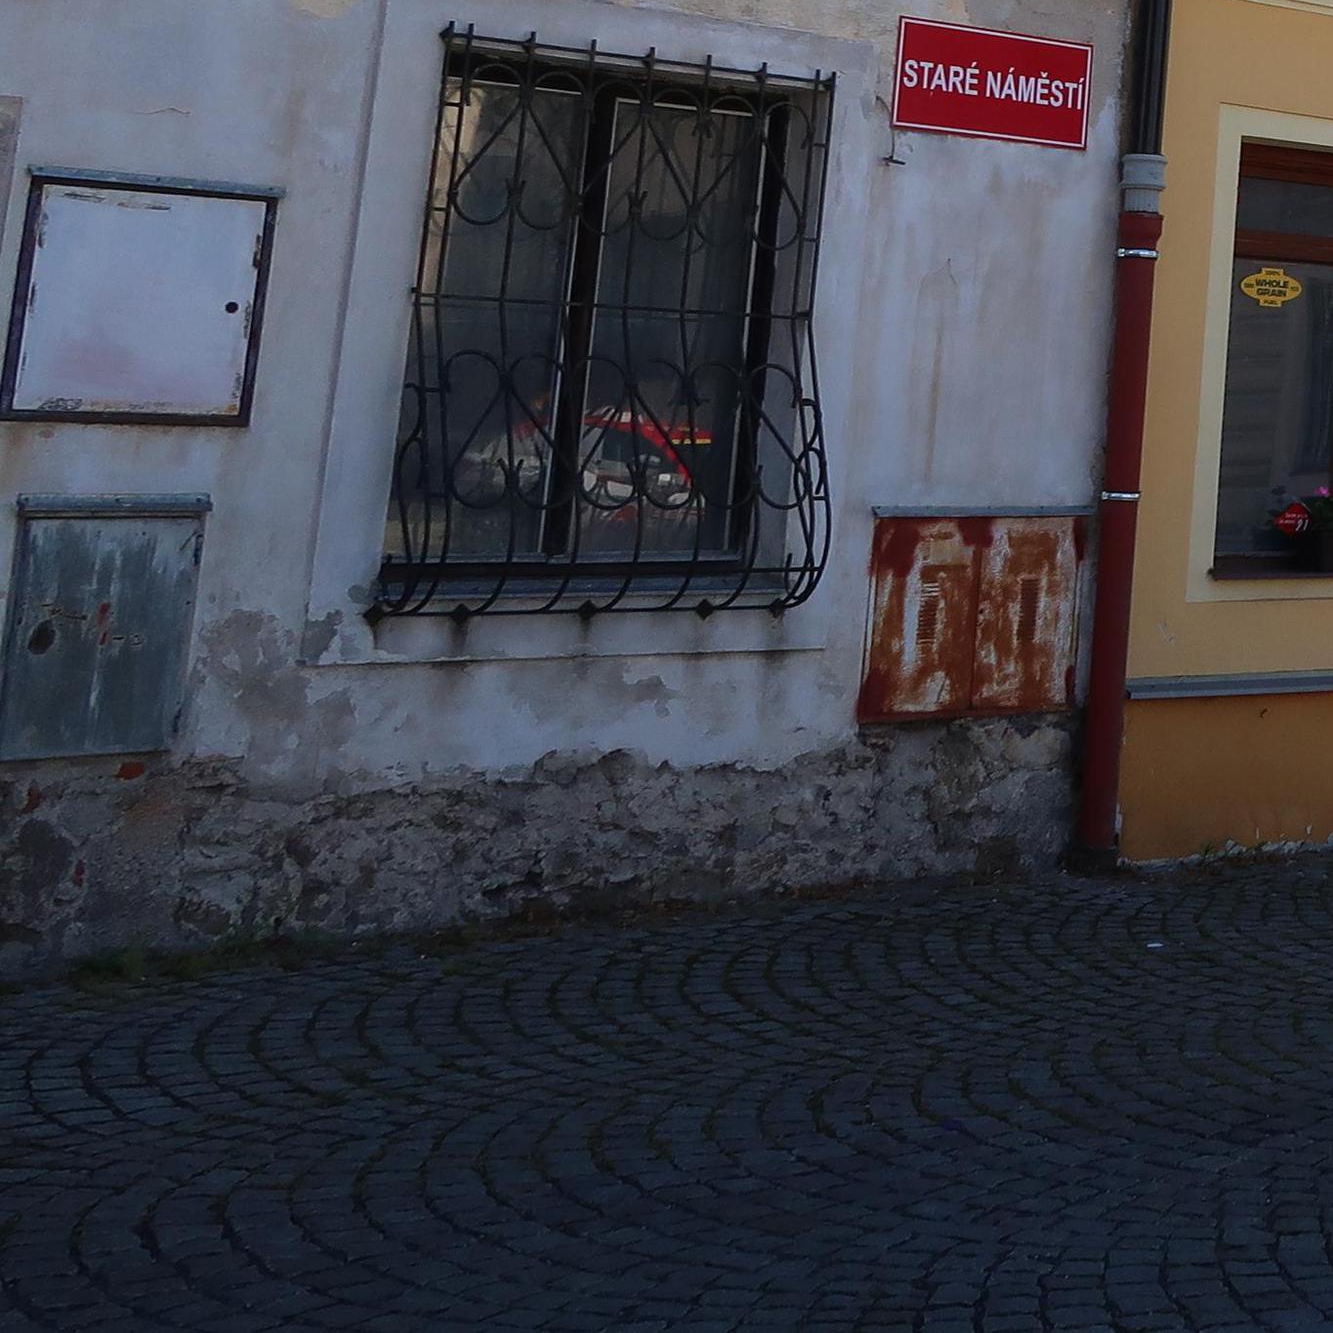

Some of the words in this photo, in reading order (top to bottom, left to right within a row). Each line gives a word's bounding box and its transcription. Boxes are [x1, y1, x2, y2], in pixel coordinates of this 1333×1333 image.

[903, 59, 979, 96] STARÉ
[986, 68, 1085, 110] NÁMĚSTÍ
[1255, 278, 1289, 288] WHOLE
[1256, 288, 1287, 297] GRAIN
